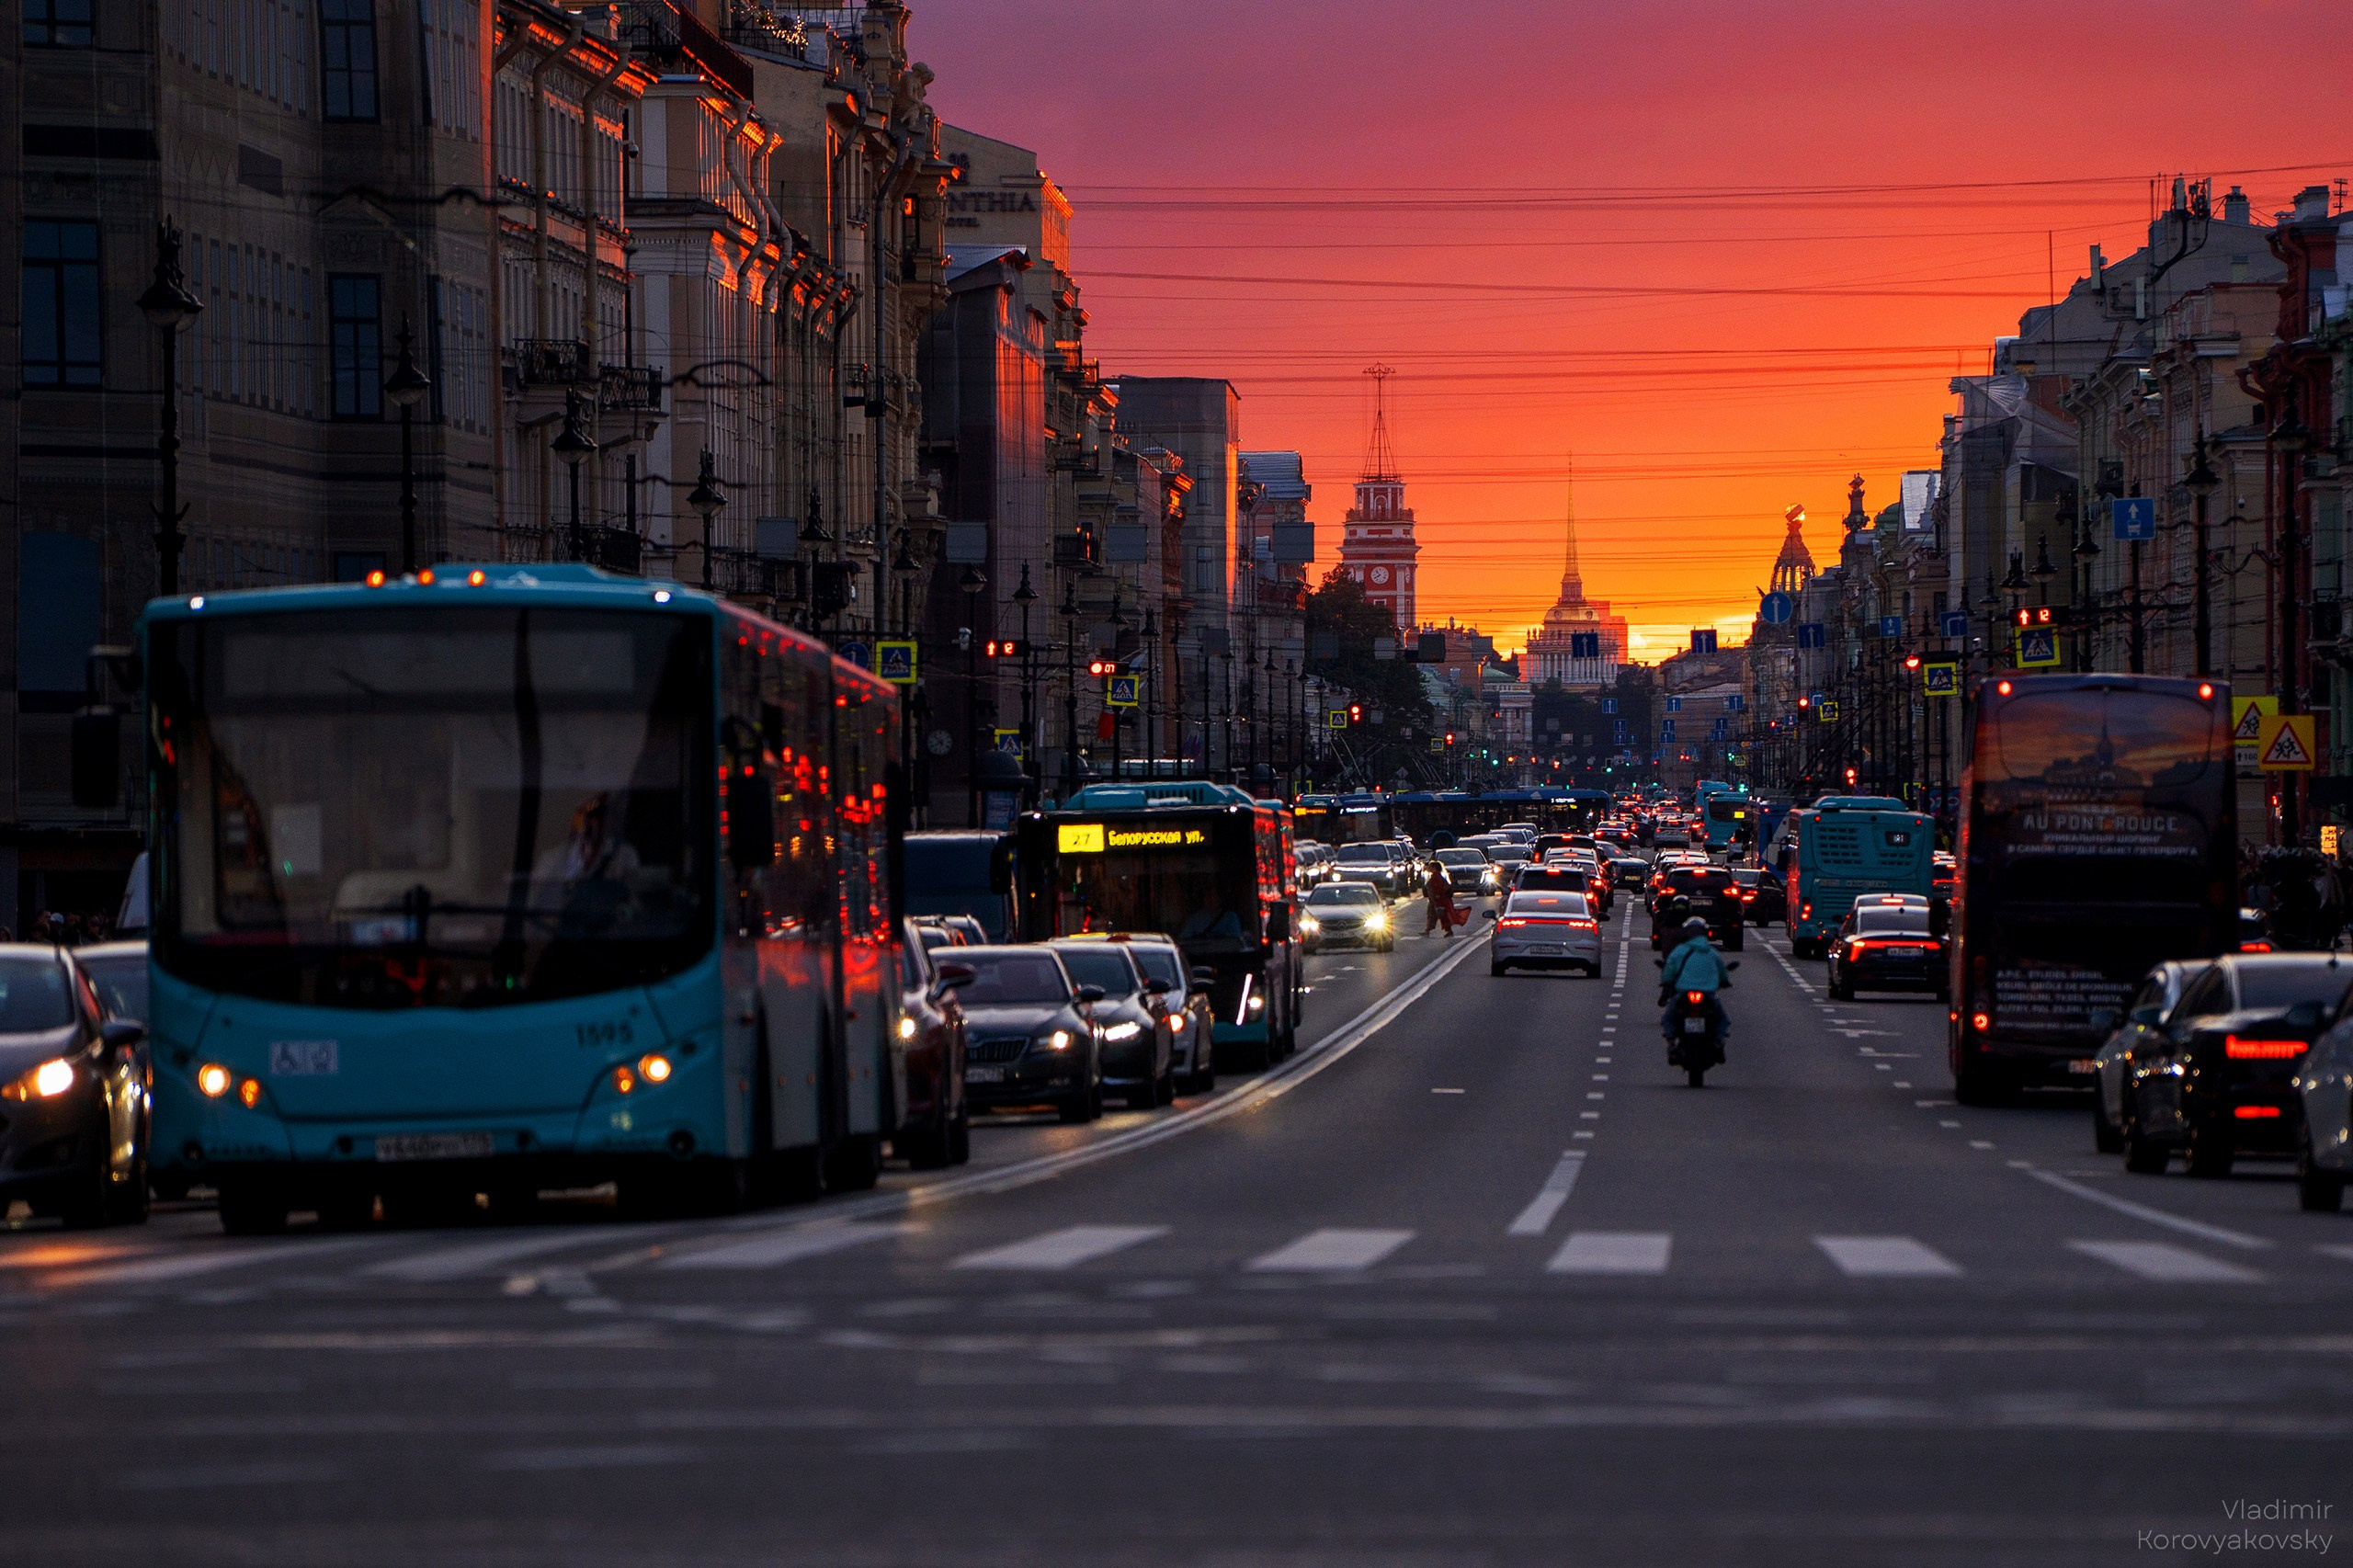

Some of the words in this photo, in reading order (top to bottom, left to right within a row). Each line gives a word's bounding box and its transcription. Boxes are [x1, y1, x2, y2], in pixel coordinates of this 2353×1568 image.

[947, 191, 1037, 212] NTHIA
[2040, 609, 2050, 621] 12
[2022, 813, 2049, 831] AU
[2054, 814, 2106, 831] PONT
[2114, 815, 2178, 832] ROUGE
[1073, 834, 1090, 846] 27
[1108, 830, 1181, 846] Белорусская
[1185, 830, 1205, 844] ул.
